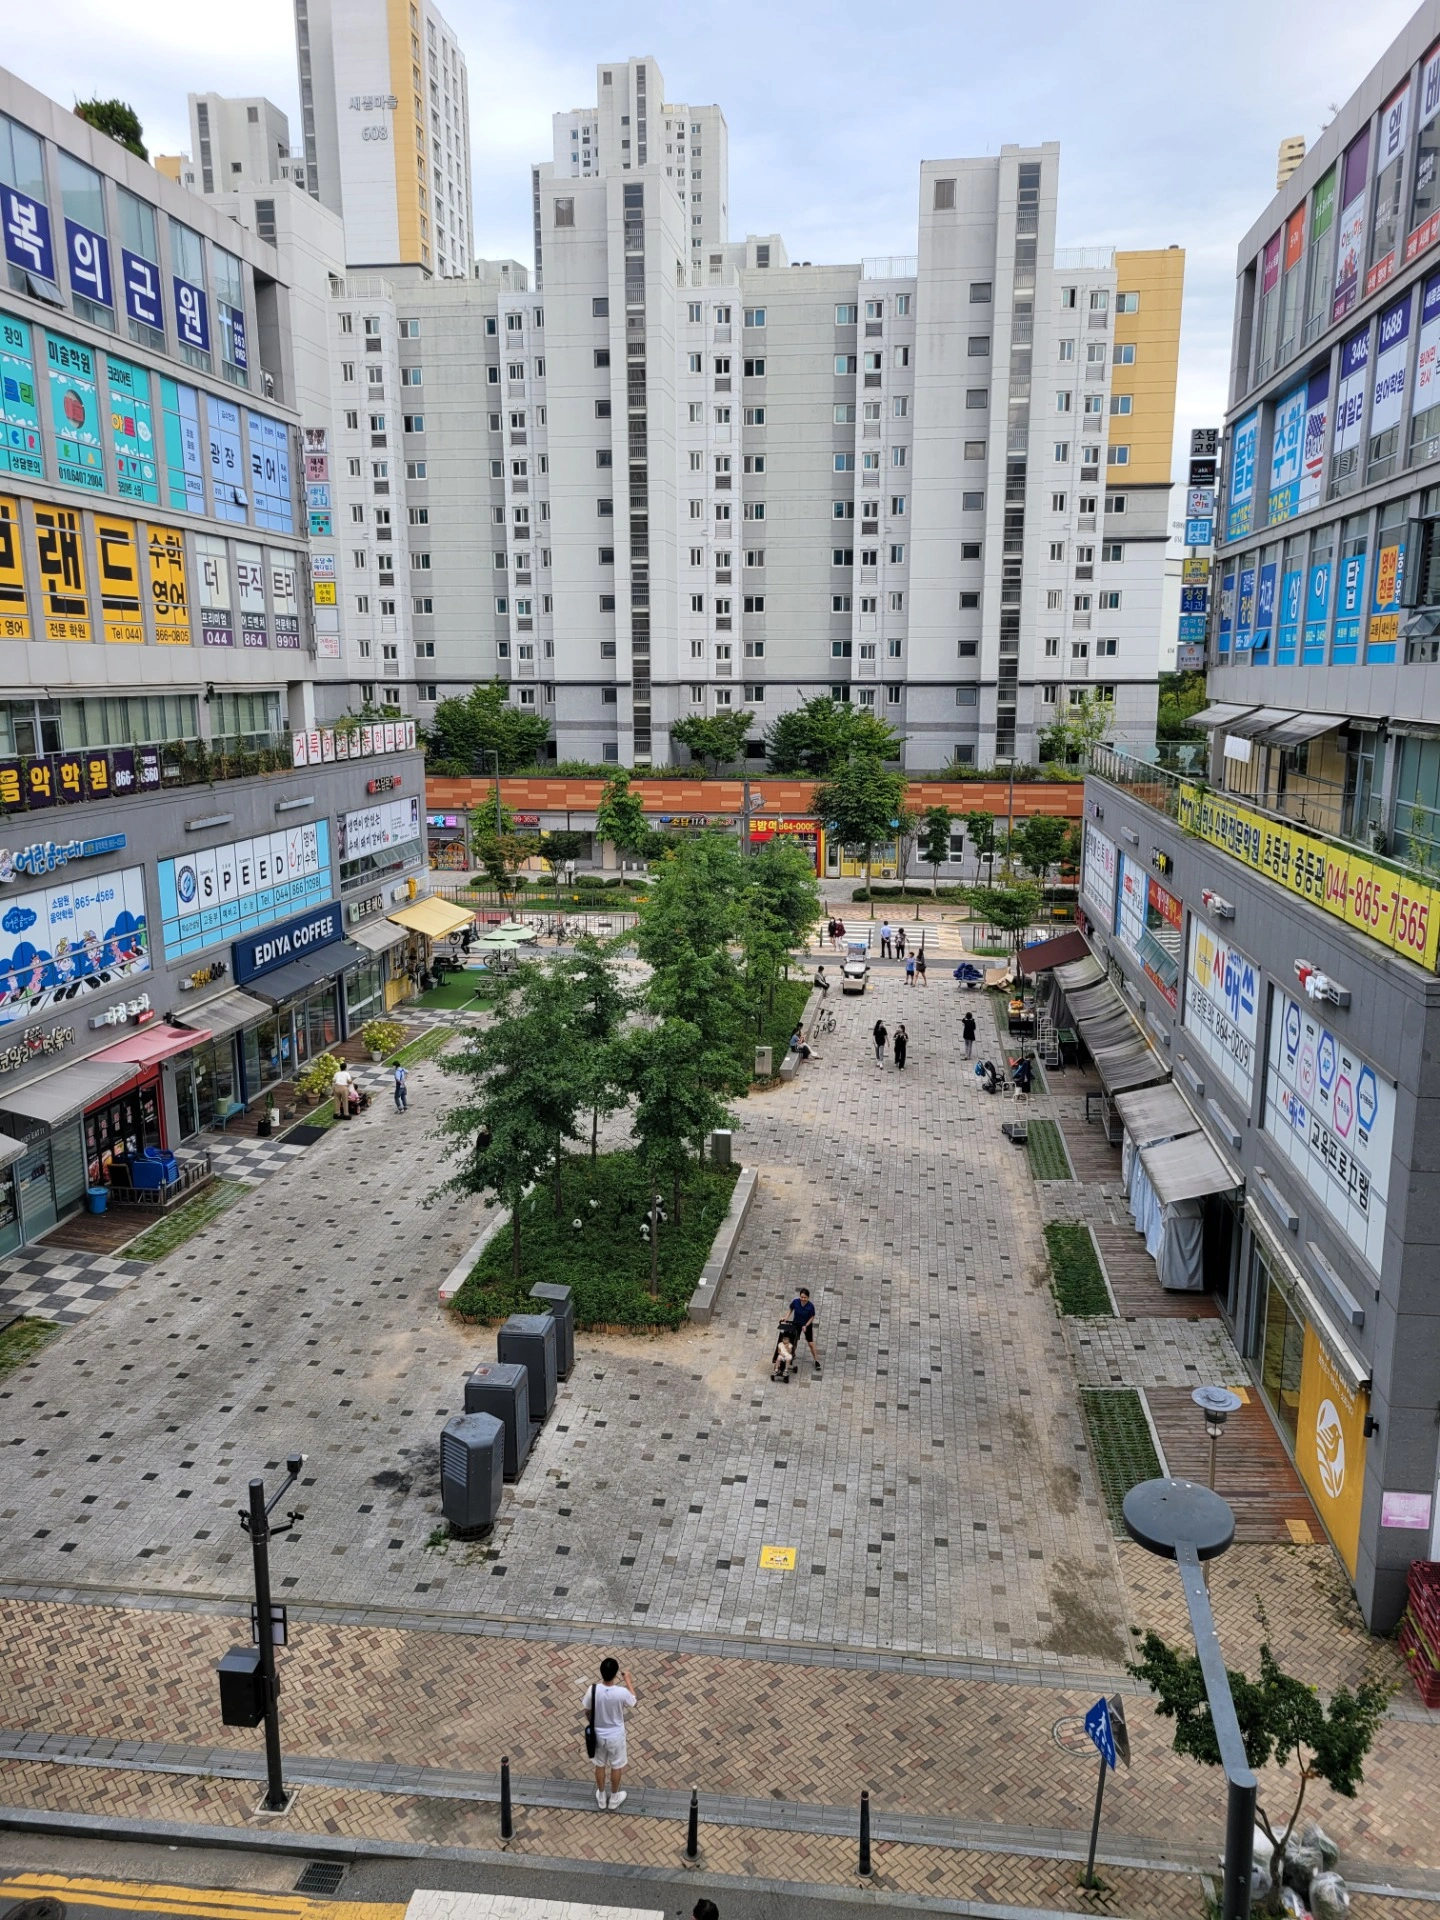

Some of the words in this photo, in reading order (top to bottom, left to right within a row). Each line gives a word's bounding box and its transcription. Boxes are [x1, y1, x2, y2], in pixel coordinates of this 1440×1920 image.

[362, 127, 388, 141] 608
[4, 325, 24, 348] 창의
[1381, 308, 1403, 344] 1688
[47, 340, 91, 375] 미술학원
[1419, 344, 1437, 369] 원어민
[1375, 367, 1405, 405] 영어학원
[1419, 367, 1432, 388] 강사
[1193, 442, 1216, 455] 교회
[1194, 429, 1217, 442] 소담
[1271, 401, 1302, 480] 수학
[11, 456, 41, 474] 상담문의
[210, 442, 235, 469] 광장
[252, 453, 277, 484] 국어
[1190, 533, 1207, 542] 수학
[148, 533, 183, 572] 수학
[1381, 549, 1397, 575] 영어
[204, 559, 220, 595] 더
[1289, 560, 1360, 620] 상아탑
[1379, 575, 1395, 601] 전문
[152, 579, 187, 617] 영어
[1183, 588, 1204, 600] 정성
[1183, 601, 1204, 612] 치과
[201, 612, 227, 627] 프리미엄
[1240, 595, 1253, 625] 정성
[5, 619, 24, 636] 영어
[50, 622, 67, 638] 전문
[69, 623, 87, 639] 학원
[112, 626, 123, 640] Tel
[125, 626, 142, 641] 044)
[156, 628, 190, 643] 866-0805
[206, 629, 228, 645] 044
[244, 632, 264, 647] 864
[276, 635, 299, 649] 9901
[275, 618, 298, 634] 전문학원
[690, 817, 705, 826] 114
[303, 831, 316, 848] 영어
[14, 841, 82, 875] 어린음악대
[304, 850, 318, 867] 수학
[203, 856, 285, 898] SPEED
[1214, 810, 1261, 864] 수학전문학원
[1326, 863, 1428, 951] 044-865-7565
[51, 894, 70, 910] 소담원
[75, 888, 115, 910] 865-4569
[260, 892, 273, 907] Tel.
[275, 888, 291, 905] 044
[291, 880, 305, 897] 866
[305, 874, 321, 892] 1098
[50, 907, 74, 924] 음악학원
[203, 911, 220, 927] 고등부
[254, 943, 292, 967] EDIYA
[292, 915, 335, 946] COFFEE
[1212, 948, 1254, 1022] 시매쓰
[1191, 986, 1215, 1025] 상담문의
[1215, 1012, 1250, 1069] 864-0209
[43, 1026, 76, 1056] 떡볶이
[1311, 1121, 1370, 1212] 교육프로그램
